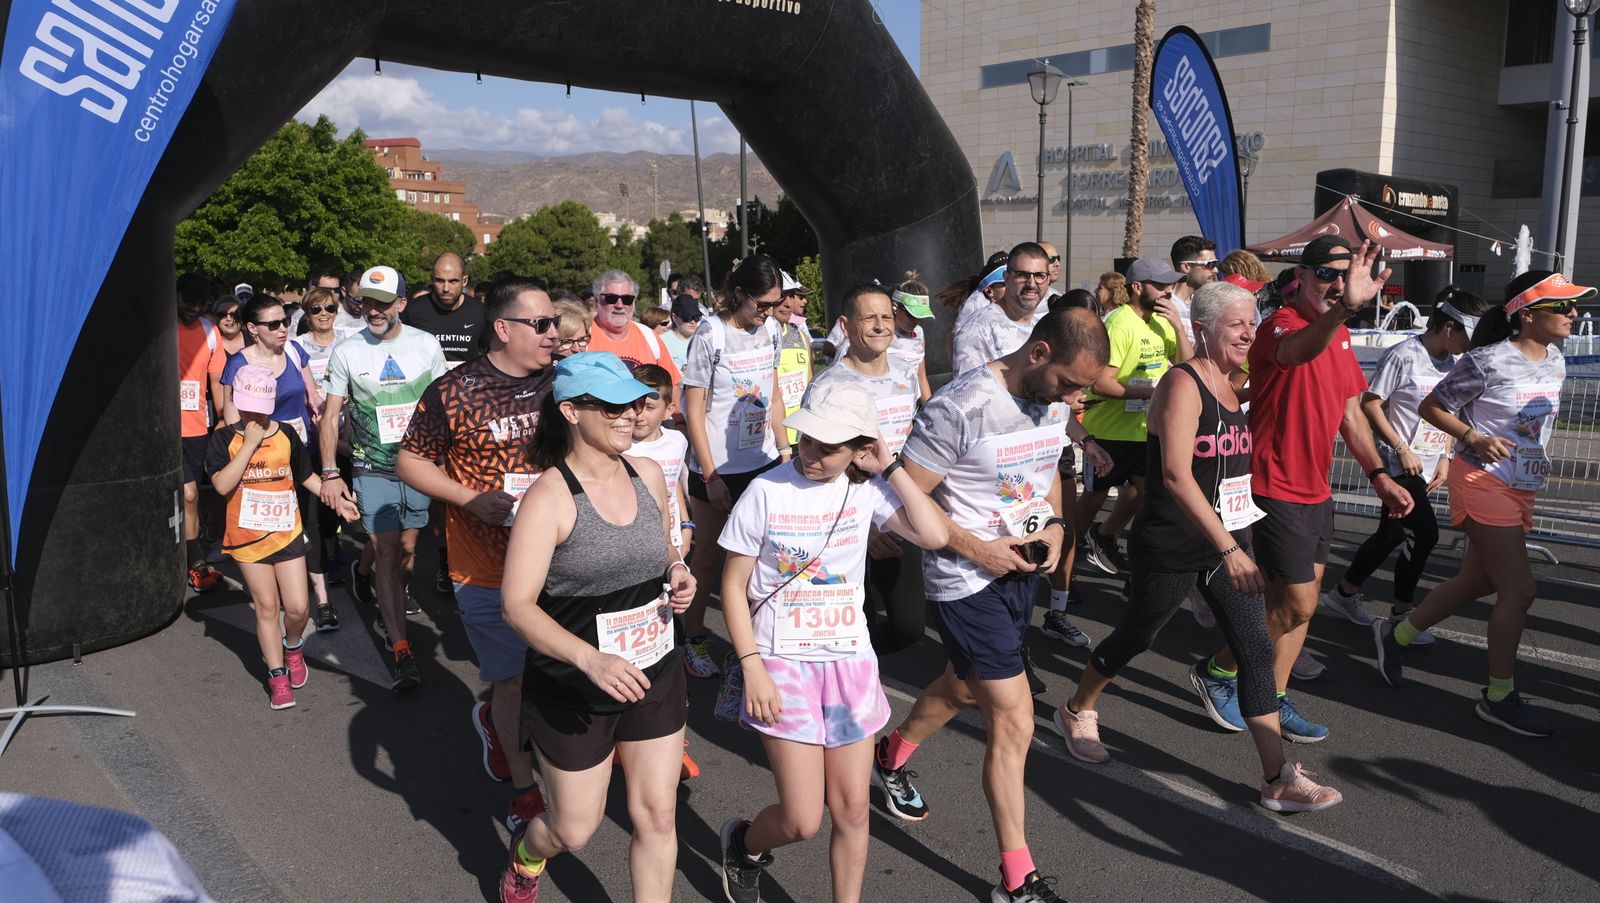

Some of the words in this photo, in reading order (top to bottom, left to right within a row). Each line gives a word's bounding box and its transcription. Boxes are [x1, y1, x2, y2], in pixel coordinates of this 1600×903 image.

[134, 0, 220, 142] centrohogarsa
[1044, 143, 1118, 164] HOSPITAL
[435, 334, 471, 342] SENTINO
[250, 502, 290, 517] 1301
[778, 513, 821, 525] CARRERA
[788, 605, 856, 628] 1300
